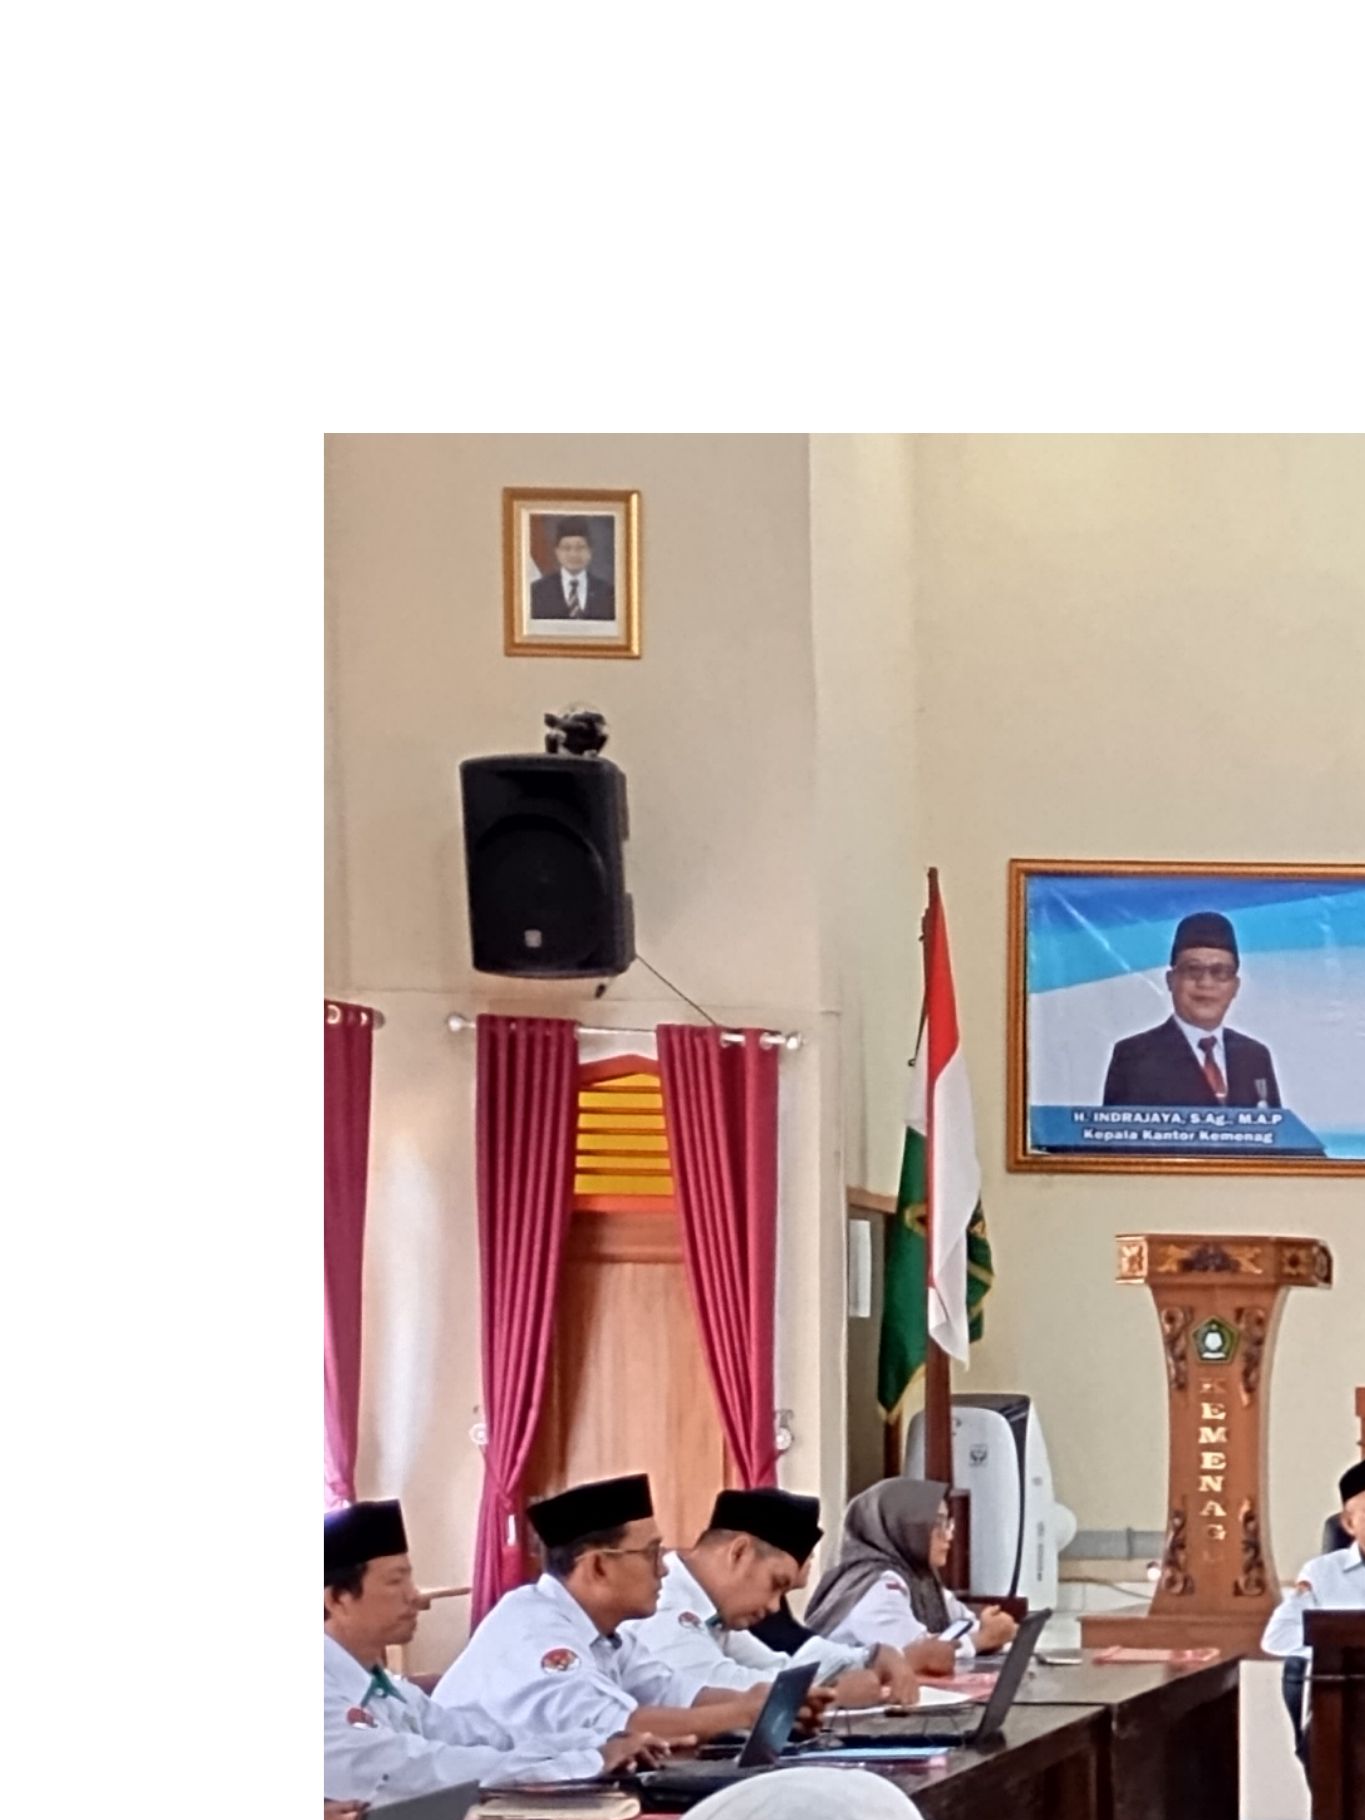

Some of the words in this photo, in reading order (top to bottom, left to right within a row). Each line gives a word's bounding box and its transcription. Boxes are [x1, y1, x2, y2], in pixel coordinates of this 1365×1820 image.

[1084, 1129, 1138, 1142] Kepala
[1143, 1130, 1195, 1141] Kantor
[1200, 1131, 1273, 1144] Kemenag
[1198, 1378, 1228, 1541] KEMENAG
